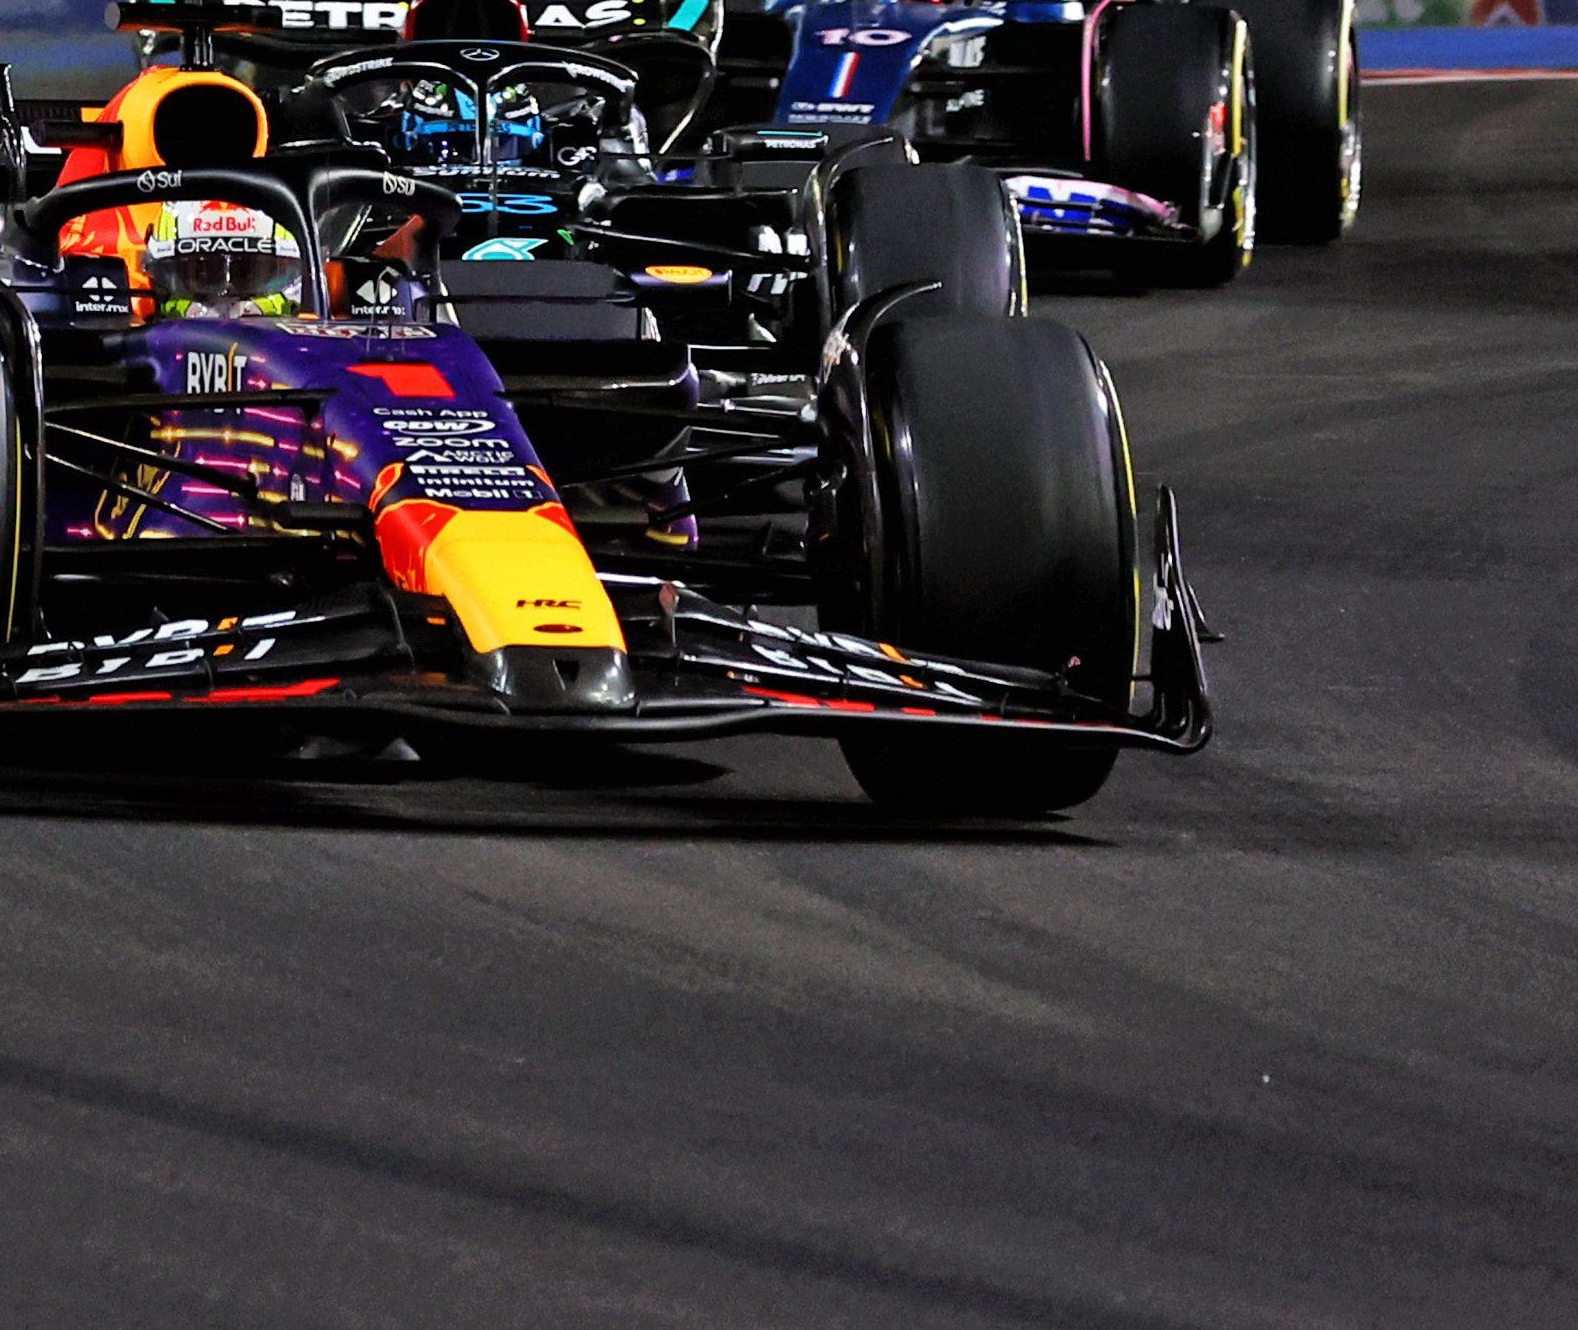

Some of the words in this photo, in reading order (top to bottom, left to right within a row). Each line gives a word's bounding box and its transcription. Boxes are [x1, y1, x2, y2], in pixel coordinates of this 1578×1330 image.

[815, 28, 912, 46] 10
[178, 237, 273, 254] ORACLE
[346, 362, 456, 398] 1
[373, 407, 433, 417] Cash
[440, 409, 489, 418] App
[424, 488, 510, 499] Mobil
[514, 599, 583, 611] HRC
